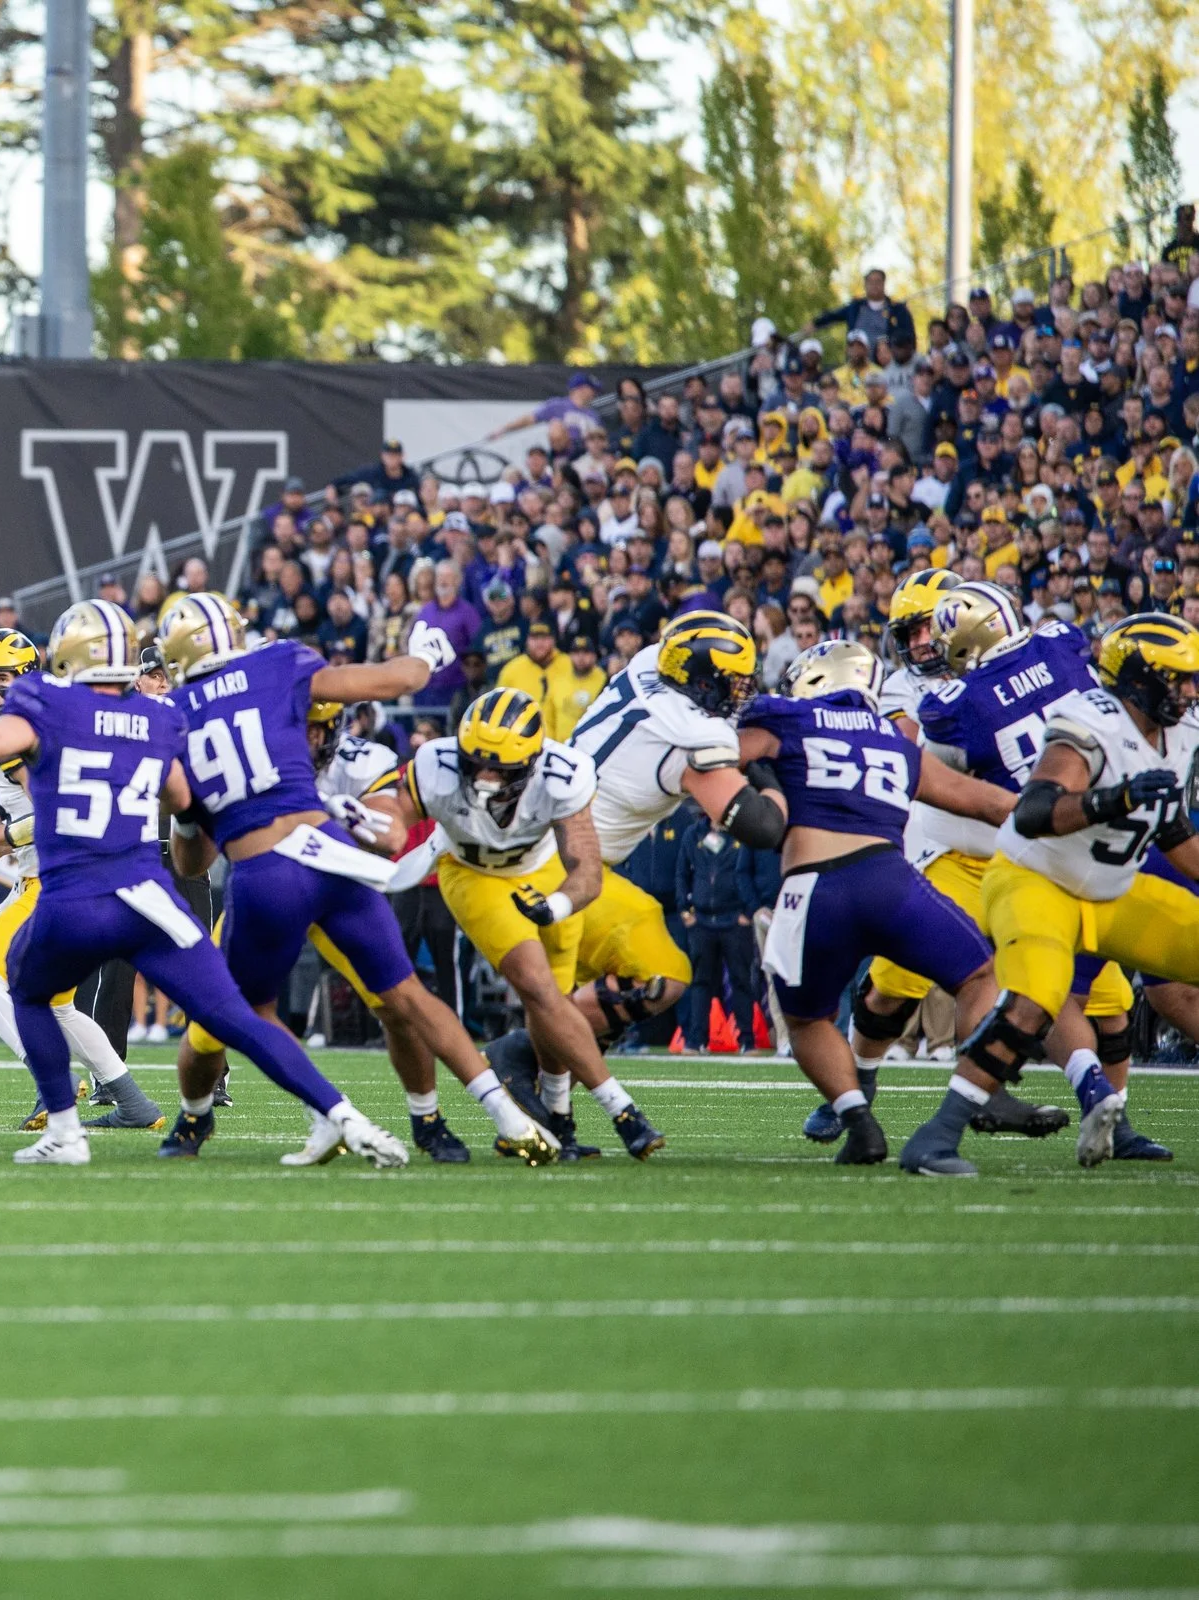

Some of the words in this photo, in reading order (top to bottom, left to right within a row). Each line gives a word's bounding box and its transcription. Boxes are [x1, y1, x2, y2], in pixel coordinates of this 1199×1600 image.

[20, 429, 289, 604] W
[203, 670, 249, 702] WARD
[1008, 661, 1054, 698] DAVIS
[94, 710, 151, 742] FOWLER
[187, 707, 282, 815] 91
[543, 752, 578, 786] 17
[55, 746, 163, 842] 54
[300, 834, 323, 857] W
[783, 892, 803, 910] W
